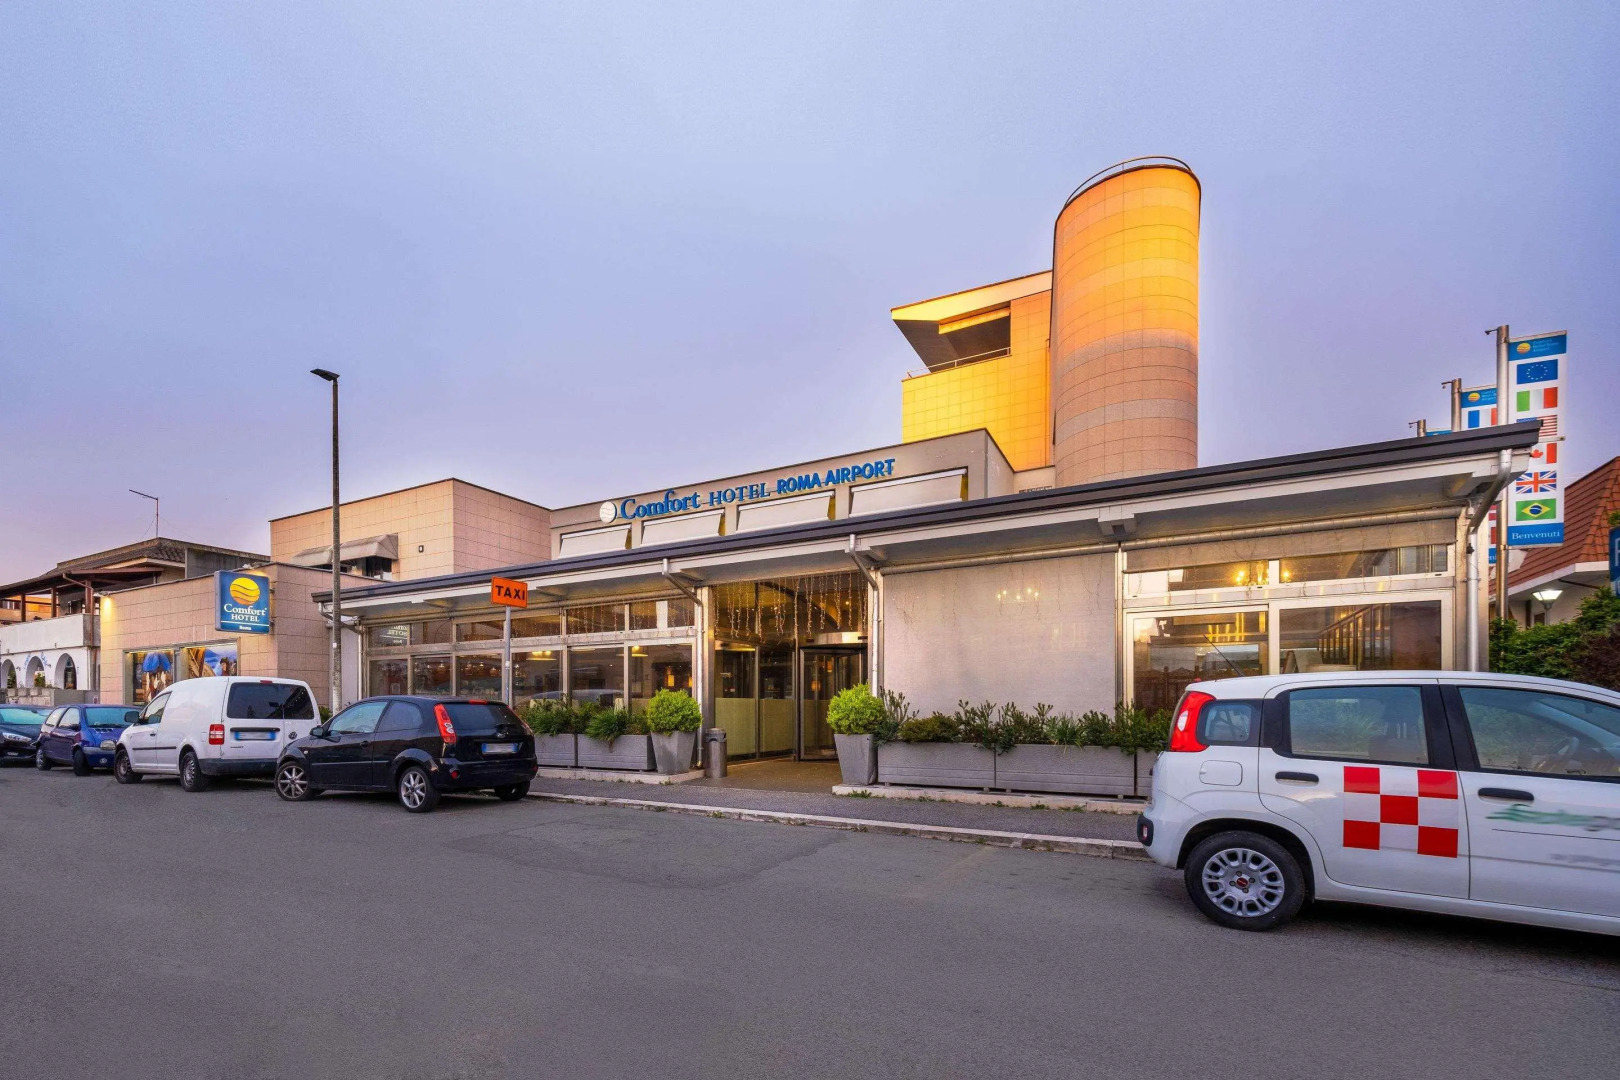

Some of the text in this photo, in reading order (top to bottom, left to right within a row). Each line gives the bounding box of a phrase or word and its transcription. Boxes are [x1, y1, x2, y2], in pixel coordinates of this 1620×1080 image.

[620, 458, 895, 520] Comfort HOTEL ROMA AIRPORT
[1511, 531, 1560, 540] Benvenuti
[495, 585, 526, 601] TAXI
[223, 603, 267, 616] Comfort
[231, 613, 260, 622] HOTEL
